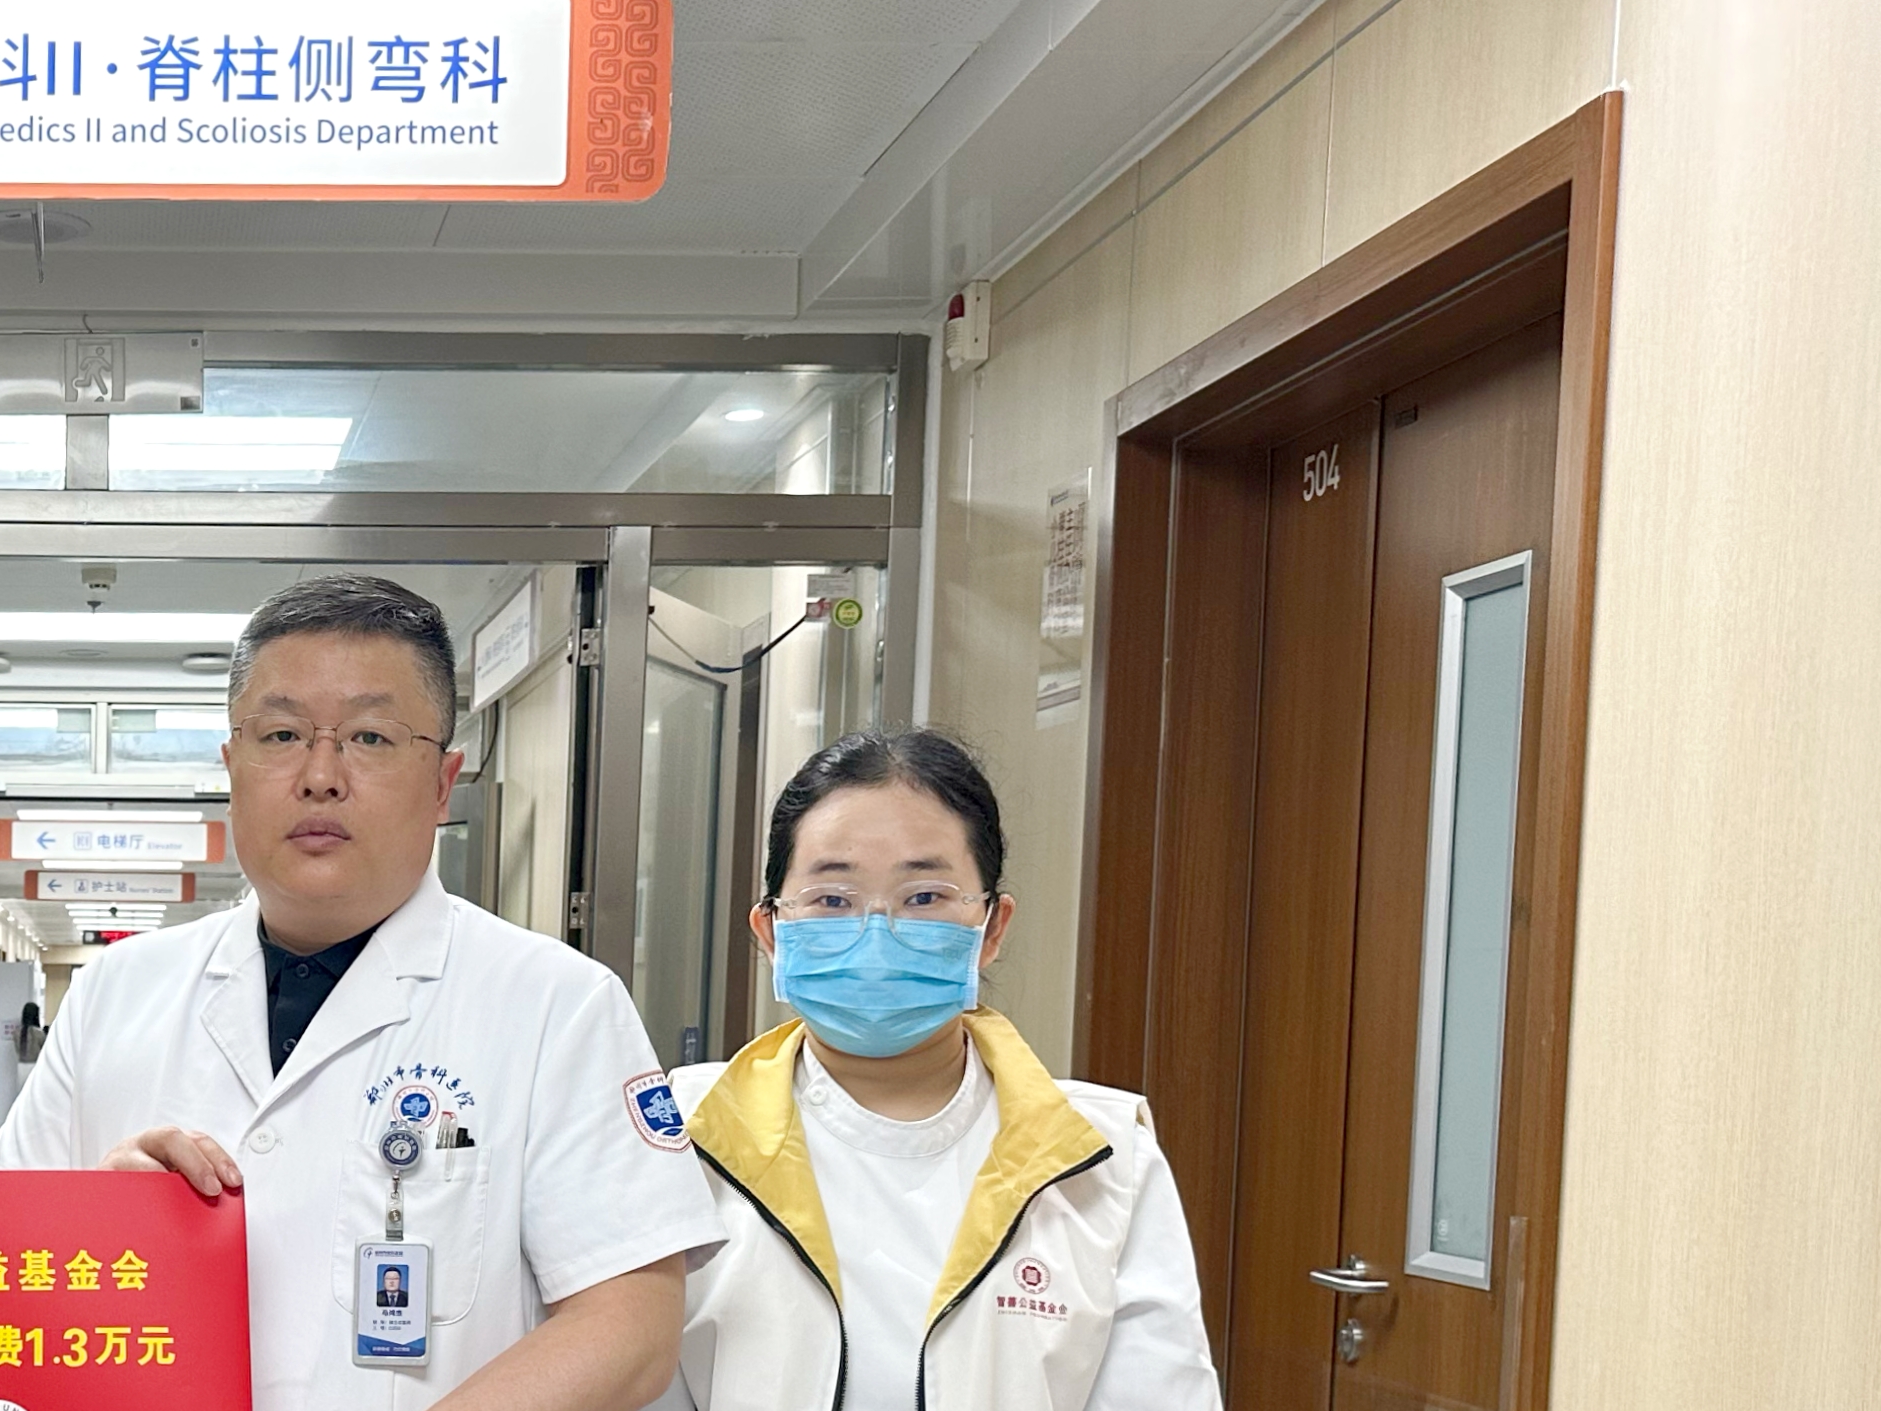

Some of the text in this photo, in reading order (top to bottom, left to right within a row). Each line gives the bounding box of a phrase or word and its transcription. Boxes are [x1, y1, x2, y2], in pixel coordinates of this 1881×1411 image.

[86, 117, 101, 143] II
[111, 116, 166, 144] and
[177, 116, 307, 144] Scoliosis
[317, 119, 500, 151] Department
[1303, 444, 1340, 502] 504
[97, 834, 144, 850] 电梯厅
[91, 881, 128, 893] 护士站
